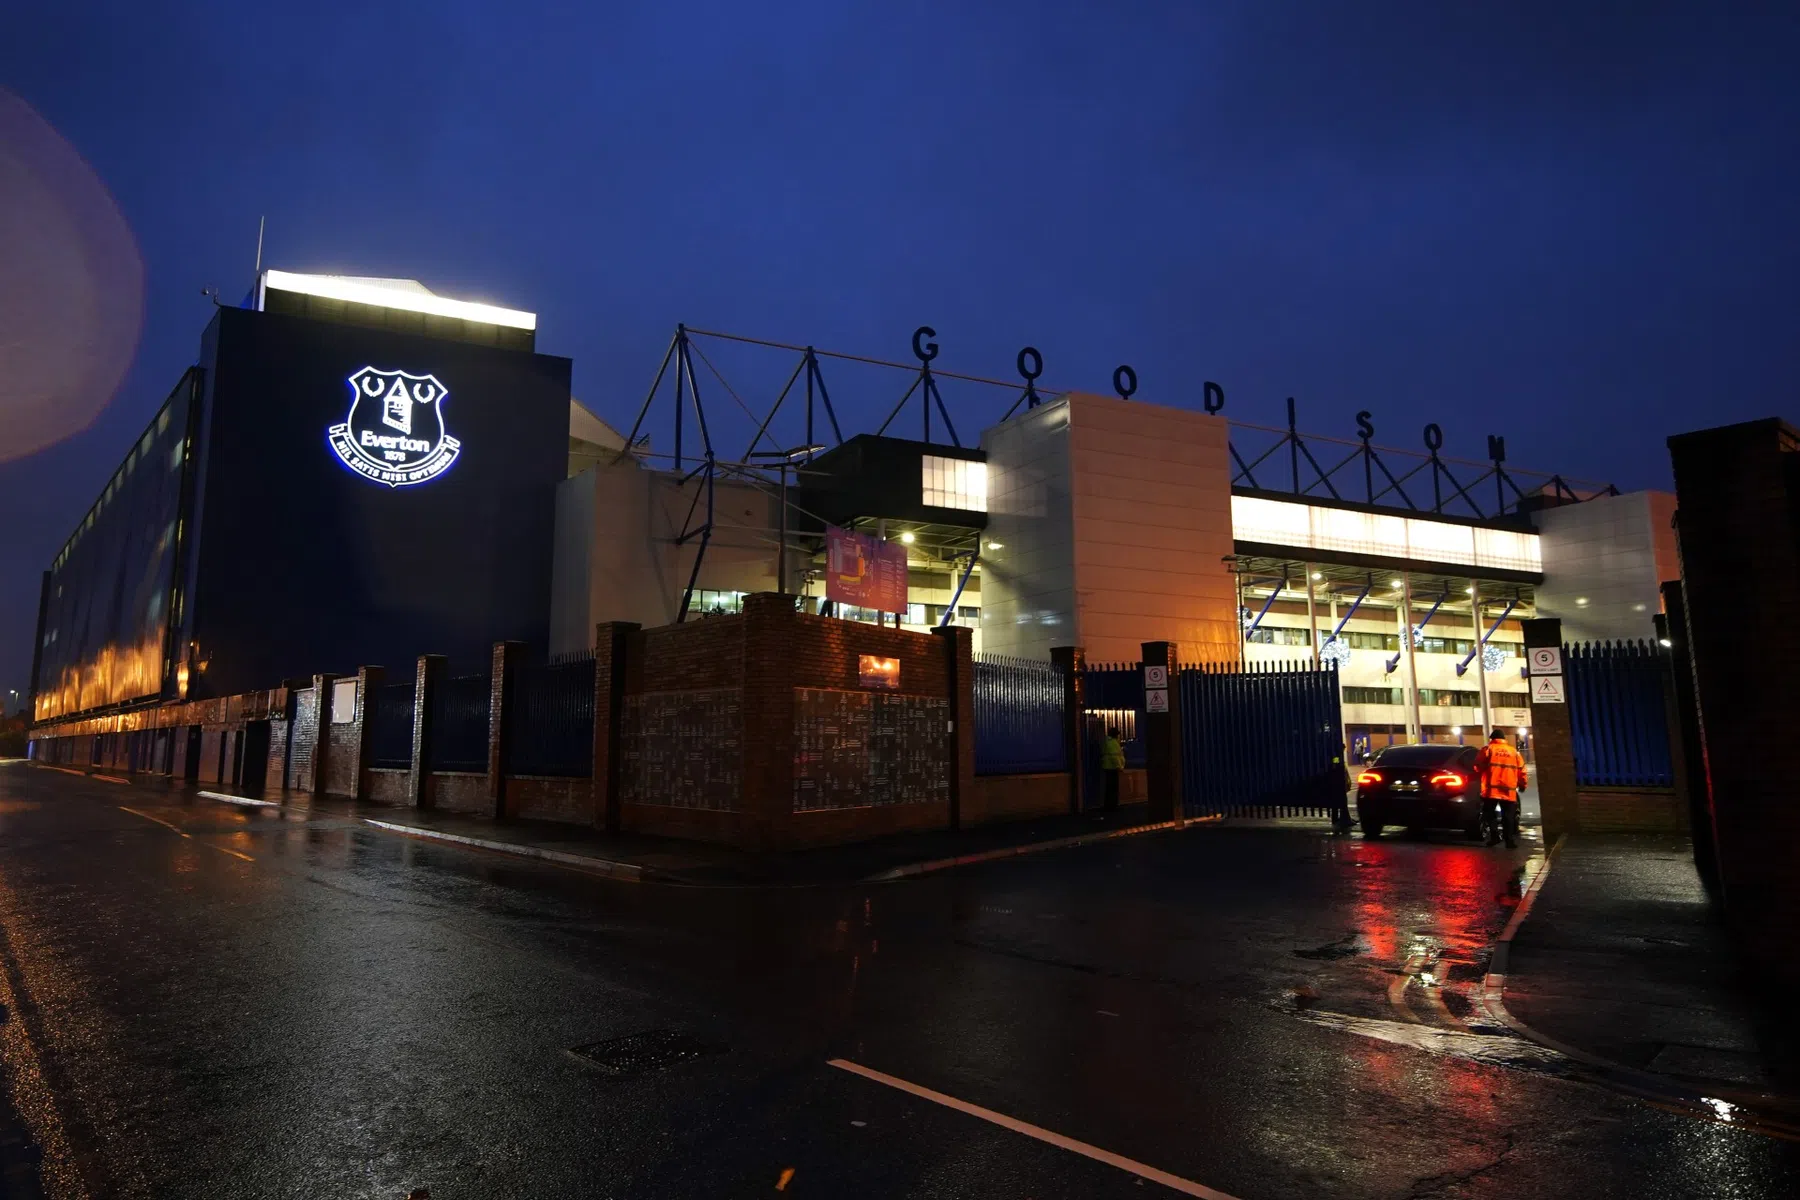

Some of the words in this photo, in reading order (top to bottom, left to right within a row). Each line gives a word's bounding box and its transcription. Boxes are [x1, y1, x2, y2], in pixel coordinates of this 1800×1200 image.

[912, 325, 1506, 463] GOODISON
[361, 430, 430, 452] Everton
[336, 440, 352, 459] NIL
[350, 457, 380, 478] SATIS
[381, 472, 407, 482] NISI
[384, 450, 406, 462] 1878
[1541, 654, 1548, 662] 5
